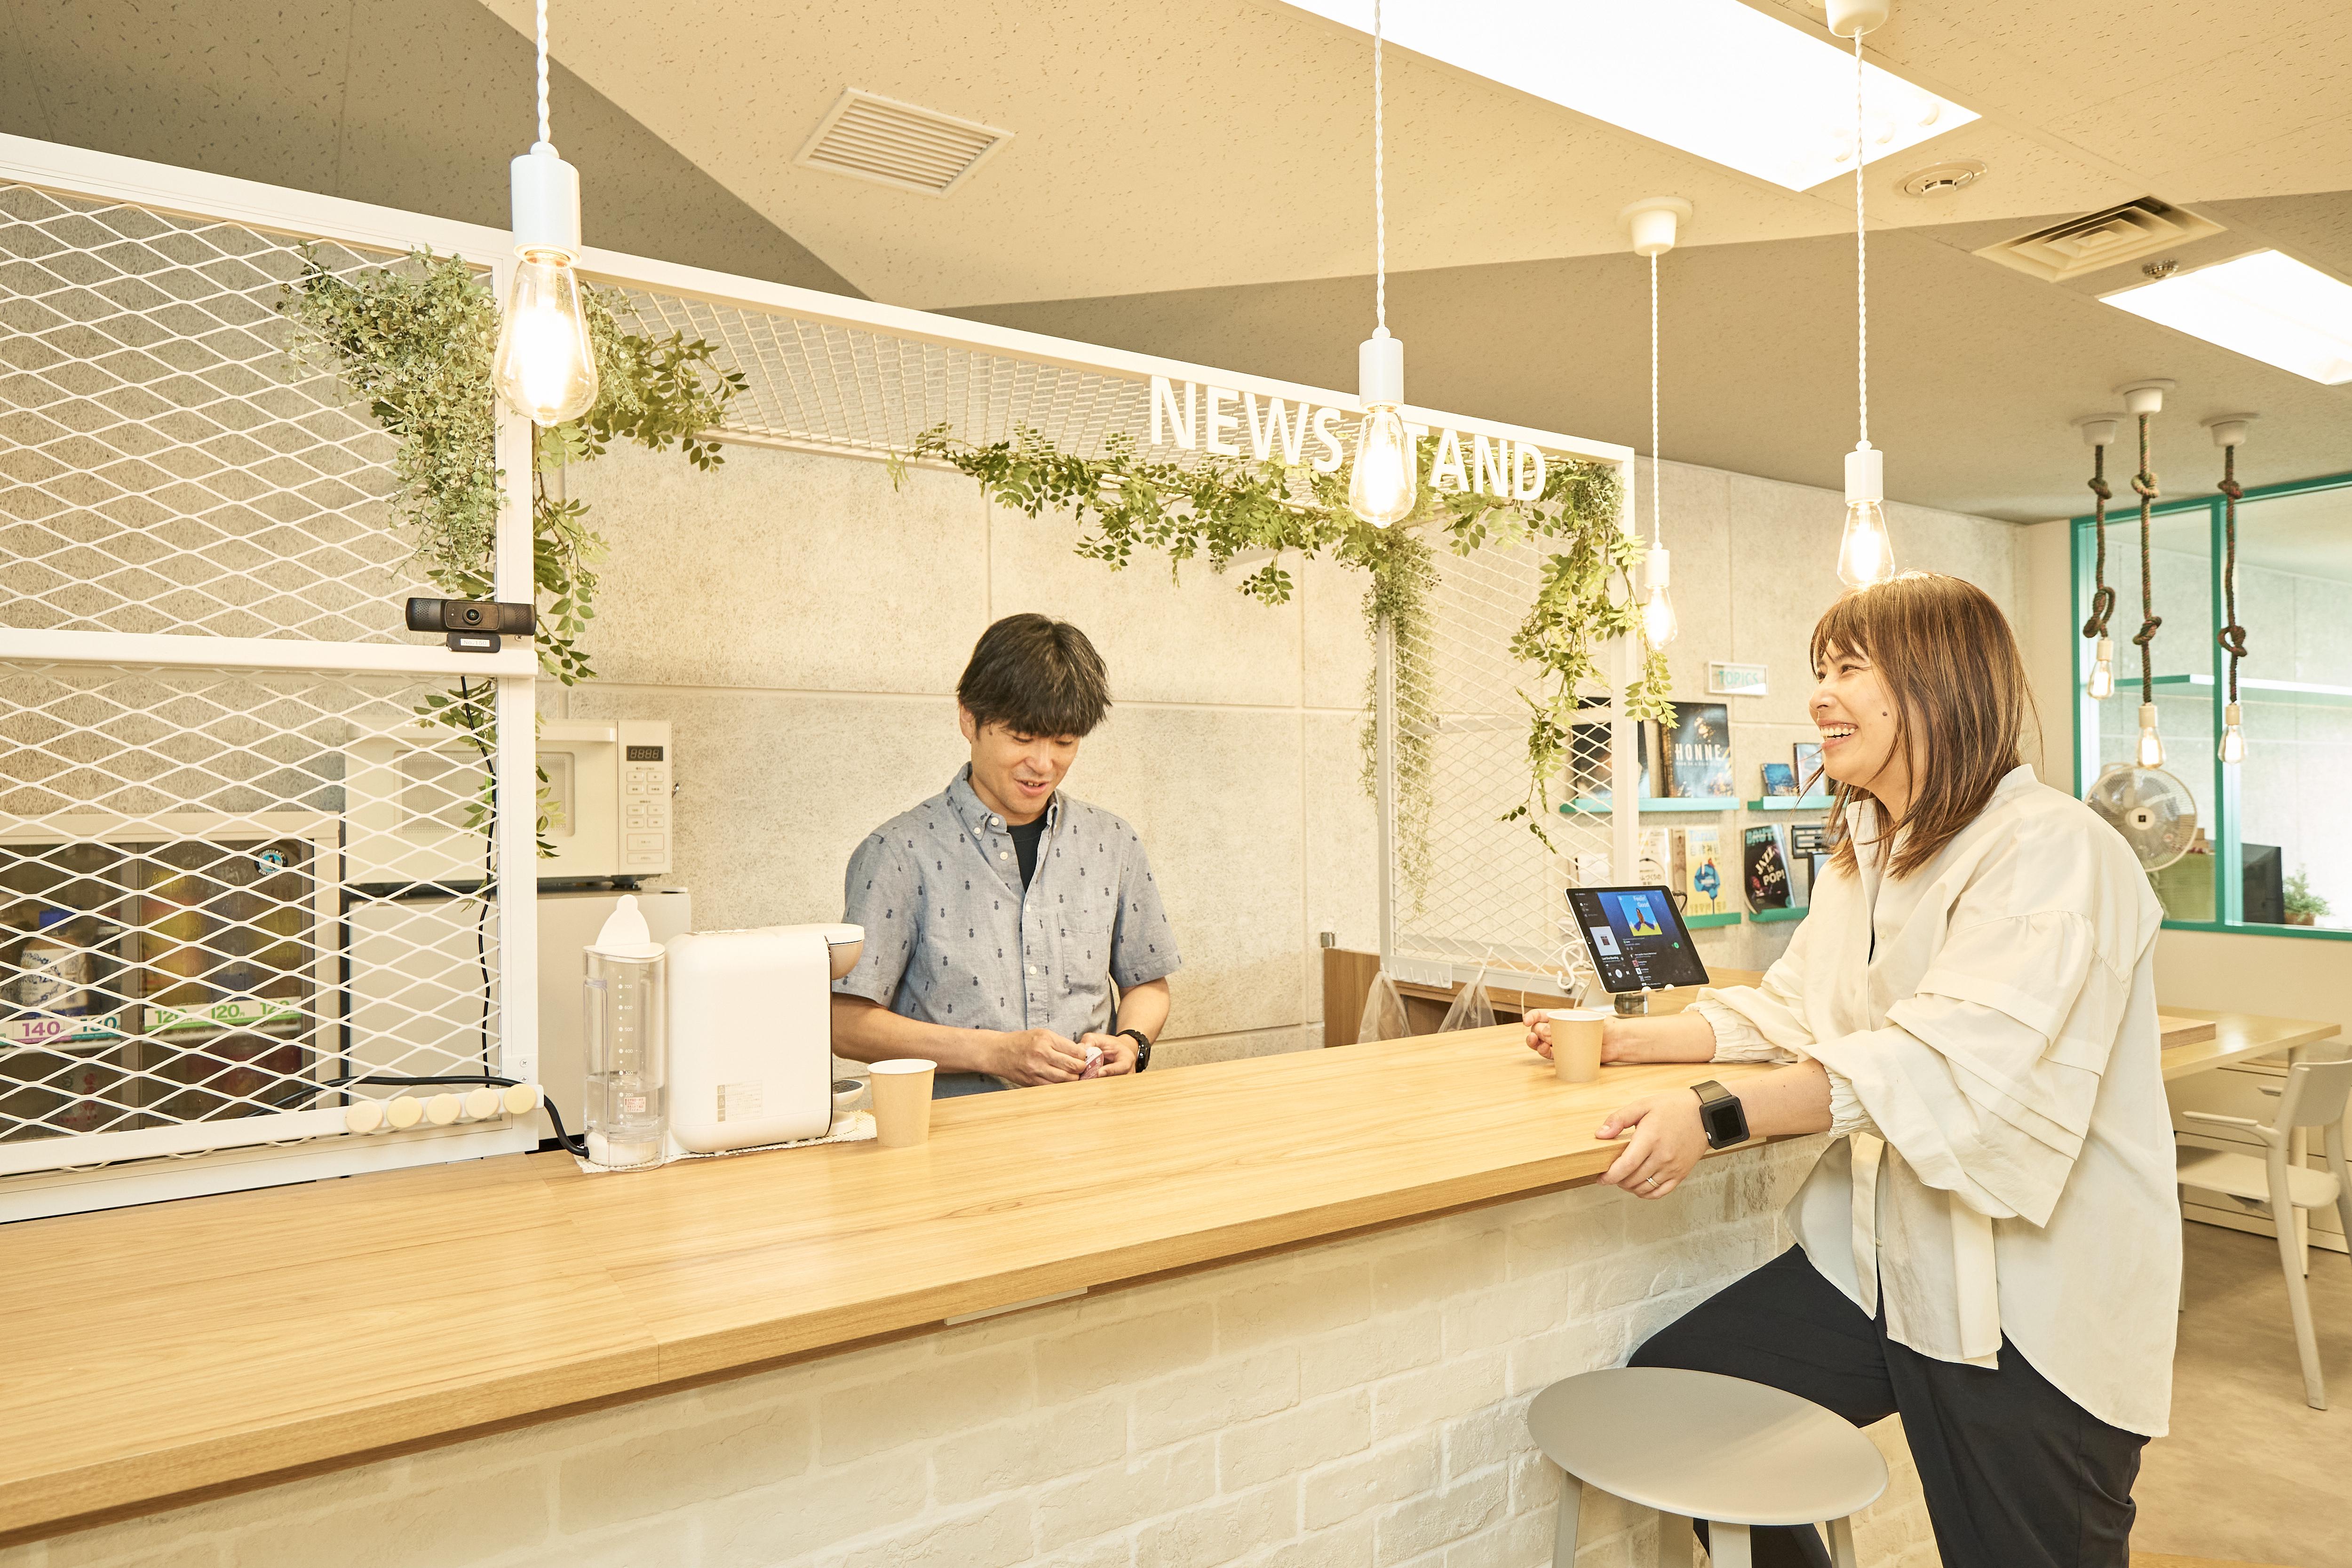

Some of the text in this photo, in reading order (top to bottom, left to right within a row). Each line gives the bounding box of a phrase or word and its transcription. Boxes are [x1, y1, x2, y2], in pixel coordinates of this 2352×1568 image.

[1151, 375, 1546, 501] NEWS TAND
[1718, 670, 1758, 685] TOPICS
[1675, 743, 1722, 761] HONNE
[1746, 828, 1774, 844] BRUT
[1755, 846, 1775, 875] JAZZ
[1763, 869, 1786, 886] POP!
